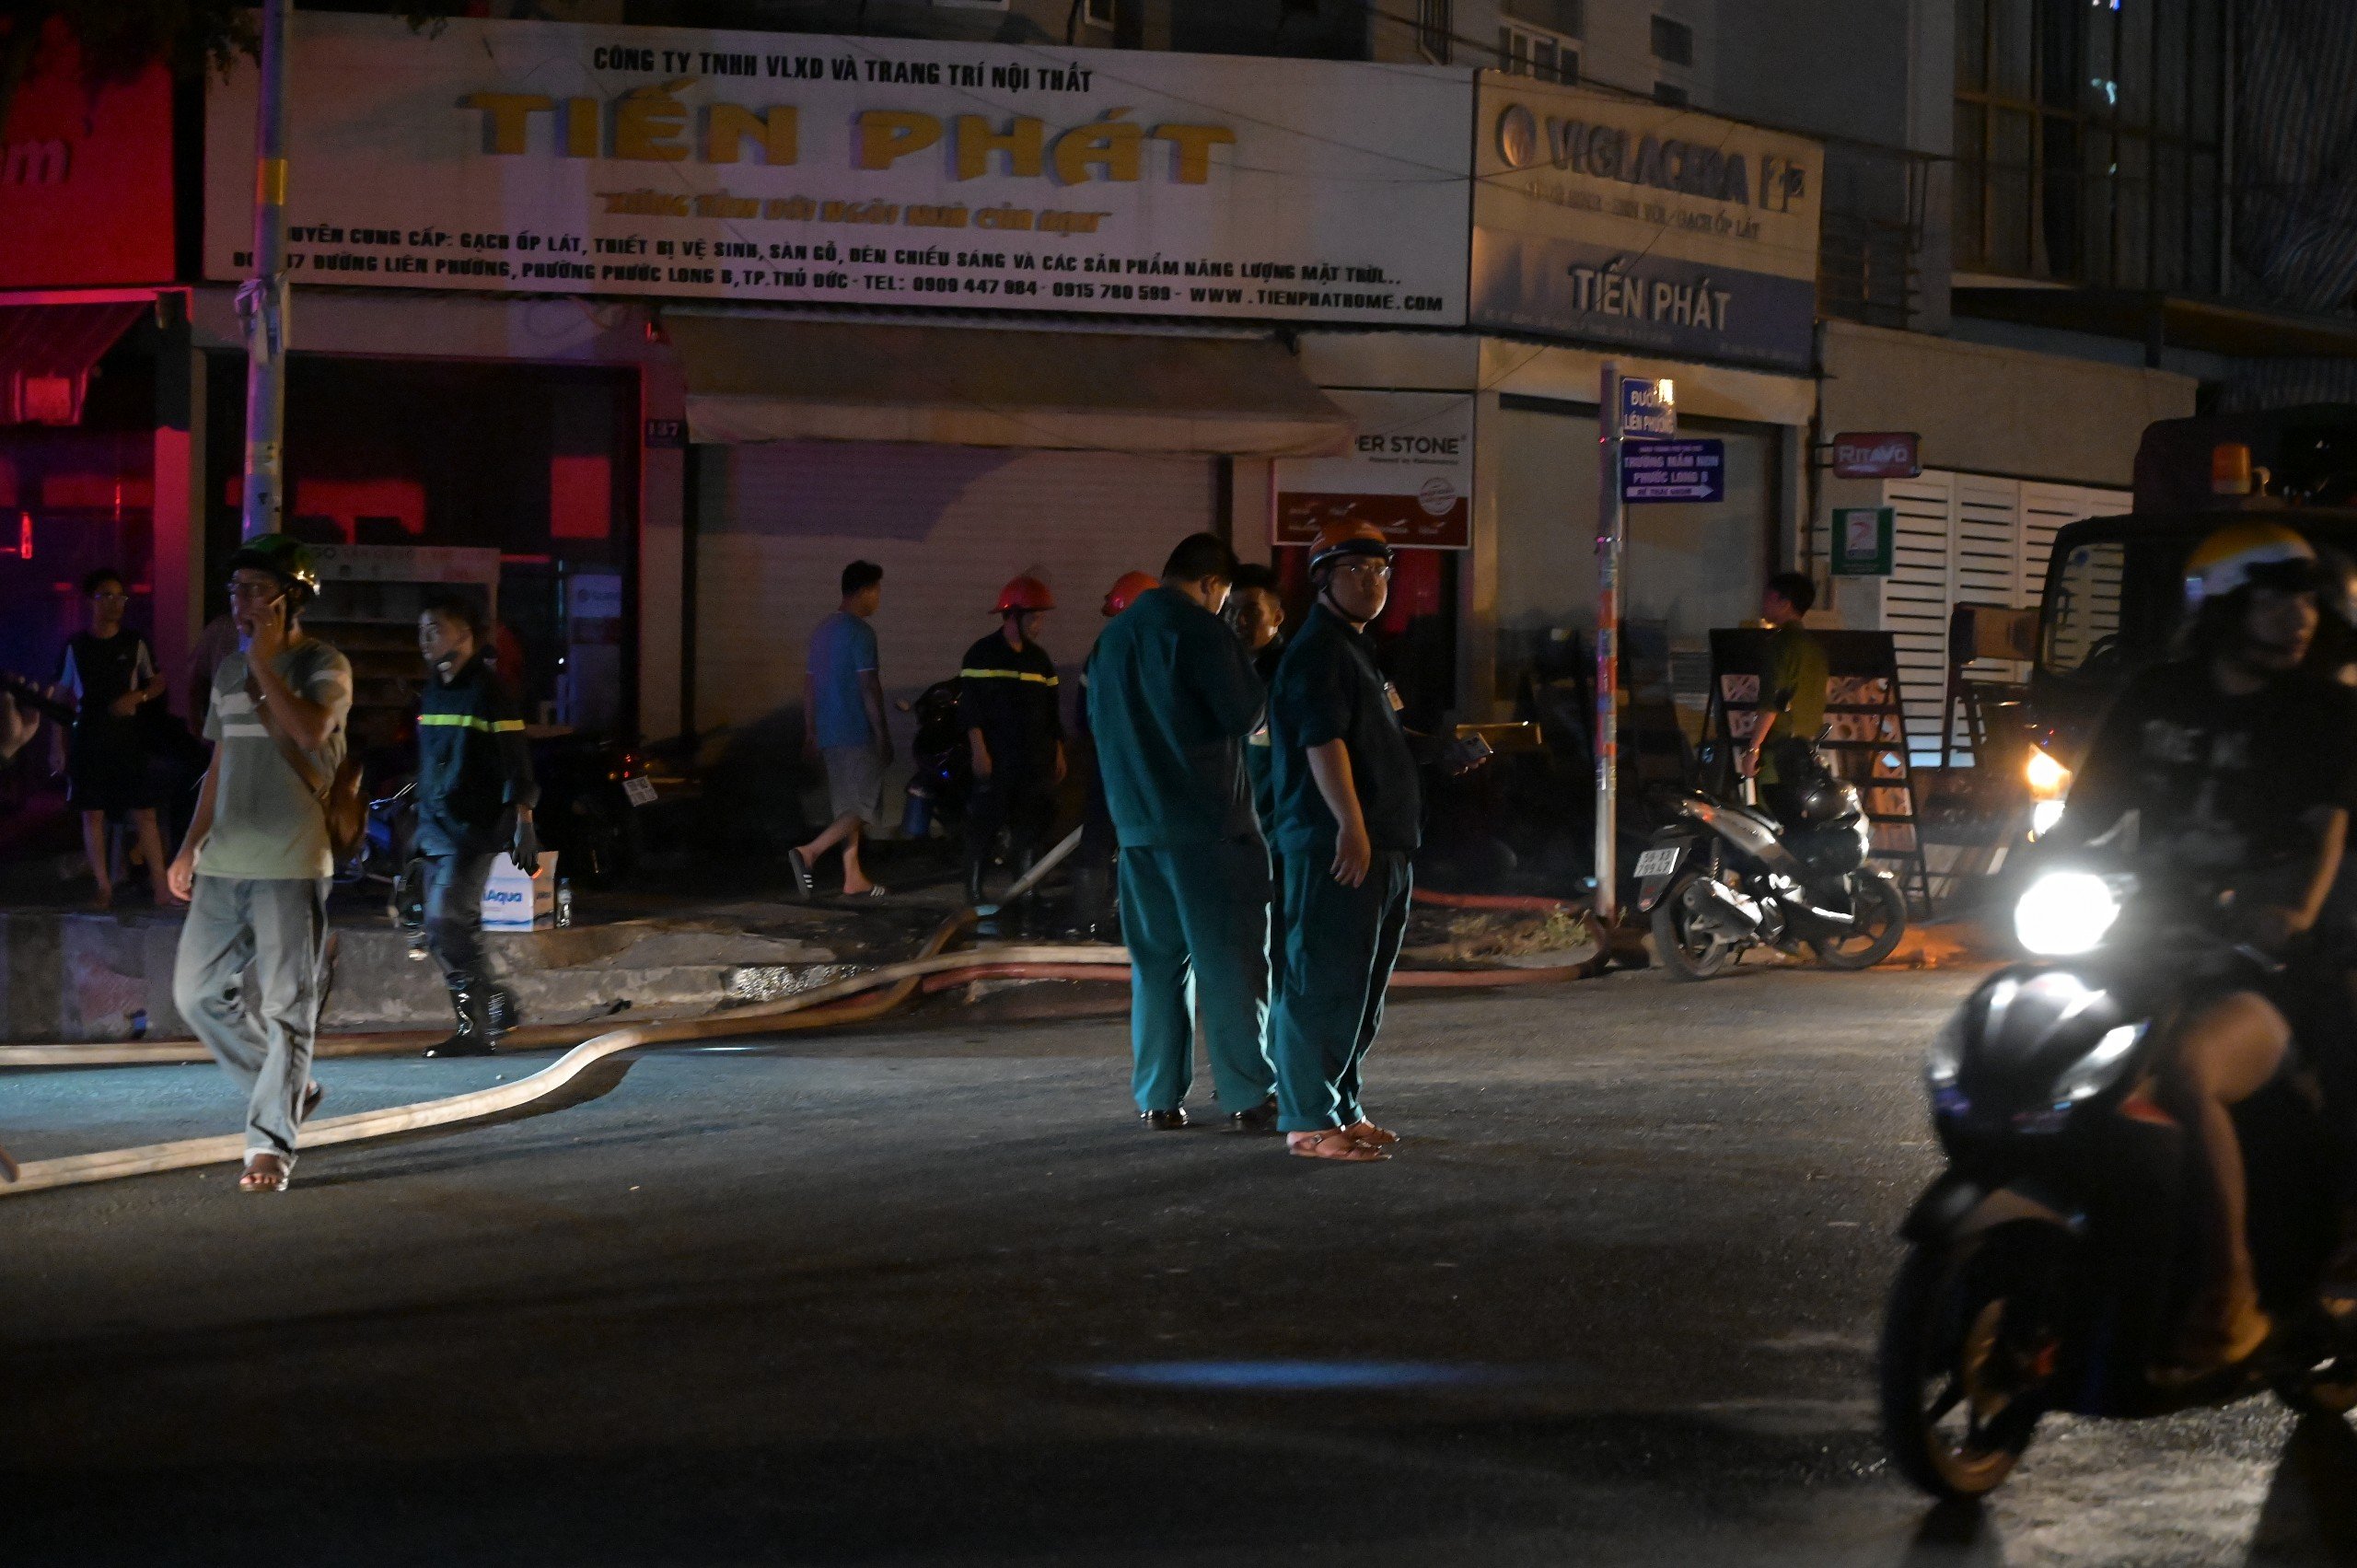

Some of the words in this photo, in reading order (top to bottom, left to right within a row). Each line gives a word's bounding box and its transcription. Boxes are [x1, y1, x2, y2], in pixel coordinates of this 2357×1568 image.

[593, 46, 654, 73] CÔNG
[662, 50, 691, 75] TY
[699, 52, 758, 77] TNHH
[767, 55, 823, 80] VLXD
[831, 53, 858, 83] VÀ
[865, 59, 940, 86] TRANG
[948, 59, 985, 88] TRÍ
[992, 64, 1029, 94] NỘI
[1039, 62, 1094, 94] THẤT
[455, 77, 799, 166] TIẾN
[854, 106, 1237, 185] PHÁT
[350, 228, 401, 246] CUNG
[408, 225, 453, 248] CẤP:
[460, 232, 509, 253] GẠCH
[516, 229, 541, 251] ỐP
[548, 232, 587, 257] LÁT,
[594, 234, 647, 256] THIẾT
[682, 238, 707, 261] VỆ
[713, 242, 765, 262] SINH,
[770, 240, 807, 261] SÀN
[894, 244, 949, 268] CHIẾU
[957, 250, 1005, 270] SÁNG
[1013, 251, 1035, 270] VÀ
[1042, 253, 1077, 272] CÁC
[1084, 252, 1120, 273] SẢN
[1126, 251, 1179, 275] PHẨM
[1184, 259, 1235, 277] NĂNG
[385, 253, 429, 273] LIÊN
[668, 267, 714, 284] LONG
[864, 274, 905, 291] TEL:
[913, 276, 958, 293] 0909
[964, 278, 999, 295] 447
[1052, 282, 1095, 298] 0915
[1569, 257, 1644, 320] TIẾN
[1654, 278, 1732, 331] PHÁT
[1355, 435, 1385, 452] ER
[1390, 436, 1459, 456] STONE
